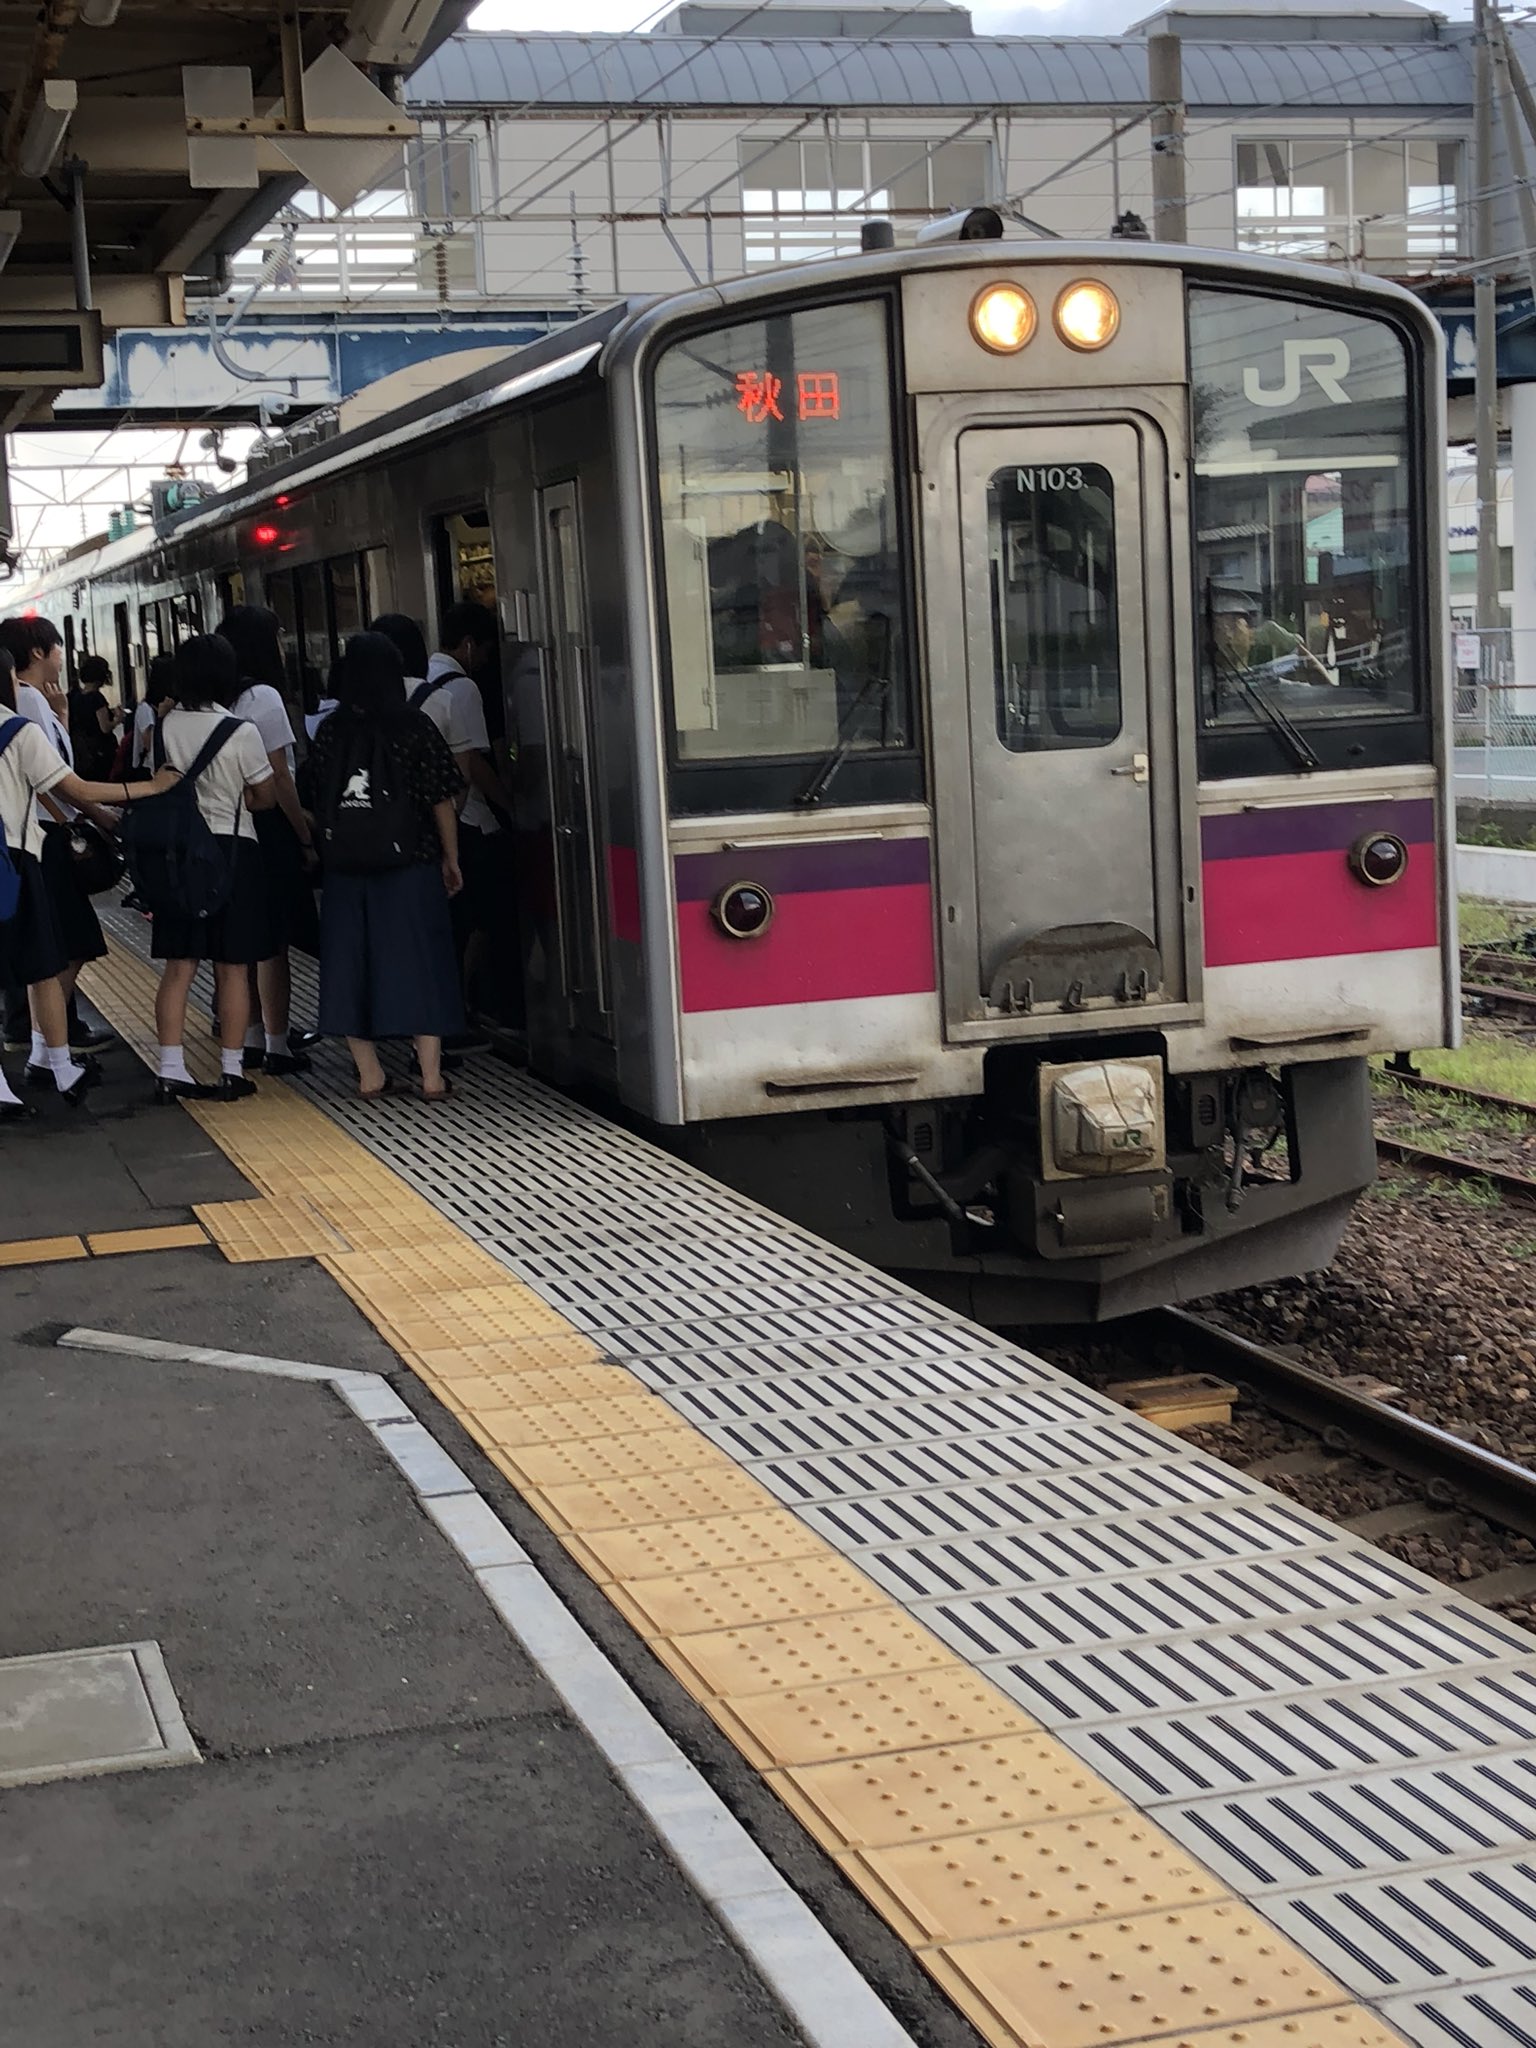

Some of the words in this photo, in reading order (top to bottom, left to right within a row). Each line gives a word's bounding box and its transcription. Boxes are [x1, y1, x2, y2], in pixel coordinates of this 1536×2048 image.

[1243, 338, 1352, 407] JR
[735, 371, 840, 422] 秋田
[1016, 467, 1083, 492] N103
[1112, 1129, 1142, 1147] JR
